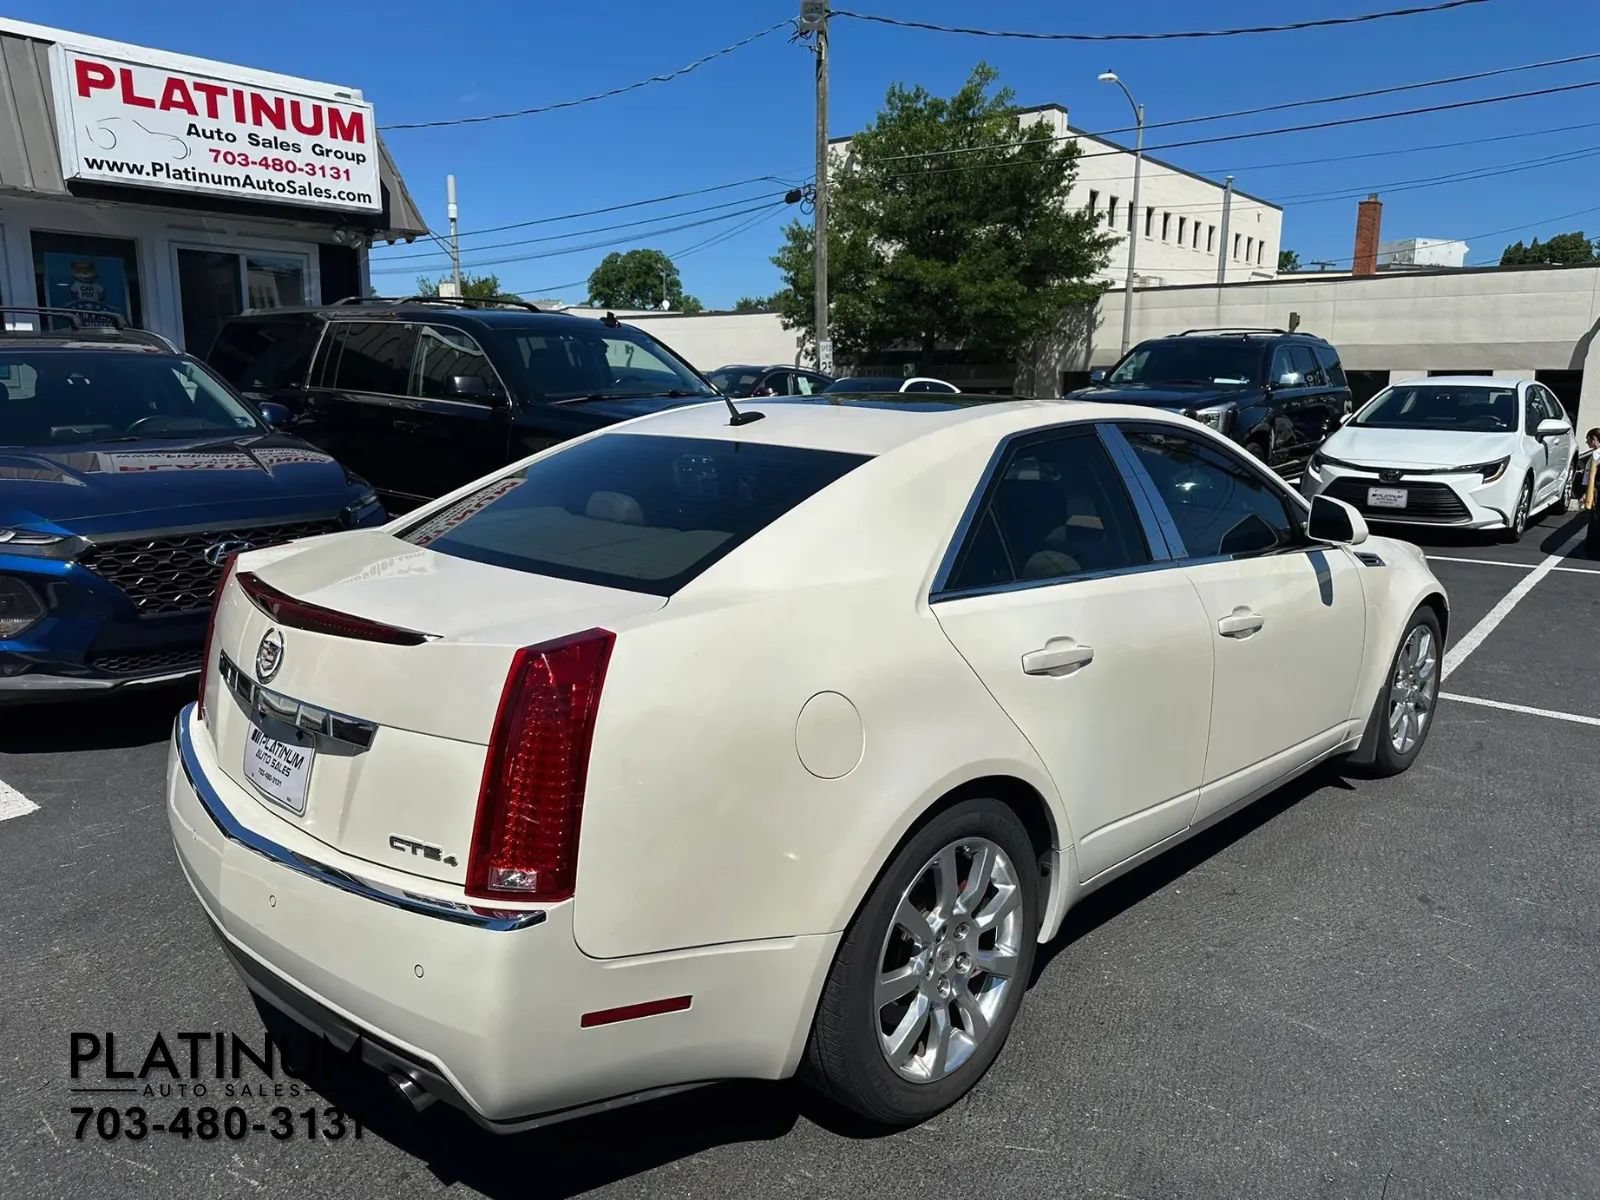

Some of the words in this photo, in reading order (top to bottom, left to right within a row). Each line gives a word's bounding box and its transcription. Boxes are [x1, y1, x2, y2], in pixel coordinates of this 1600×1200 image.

[74, 59, 365, 144] PLATINUM
[186, 123, 237, 143] Auto
[247, 133, 302, 154] Sales
[311, 143, 367, 165] Group
[84, 156, 373, 204] www.PlatinumAutoSales.com
[208, 148, 352, 182] 703-480-3131
[255, 749, 271, 764] AUTO
[270, 758, 292, 777] SALES
[259, 734, 305, 770] PLATINUM
